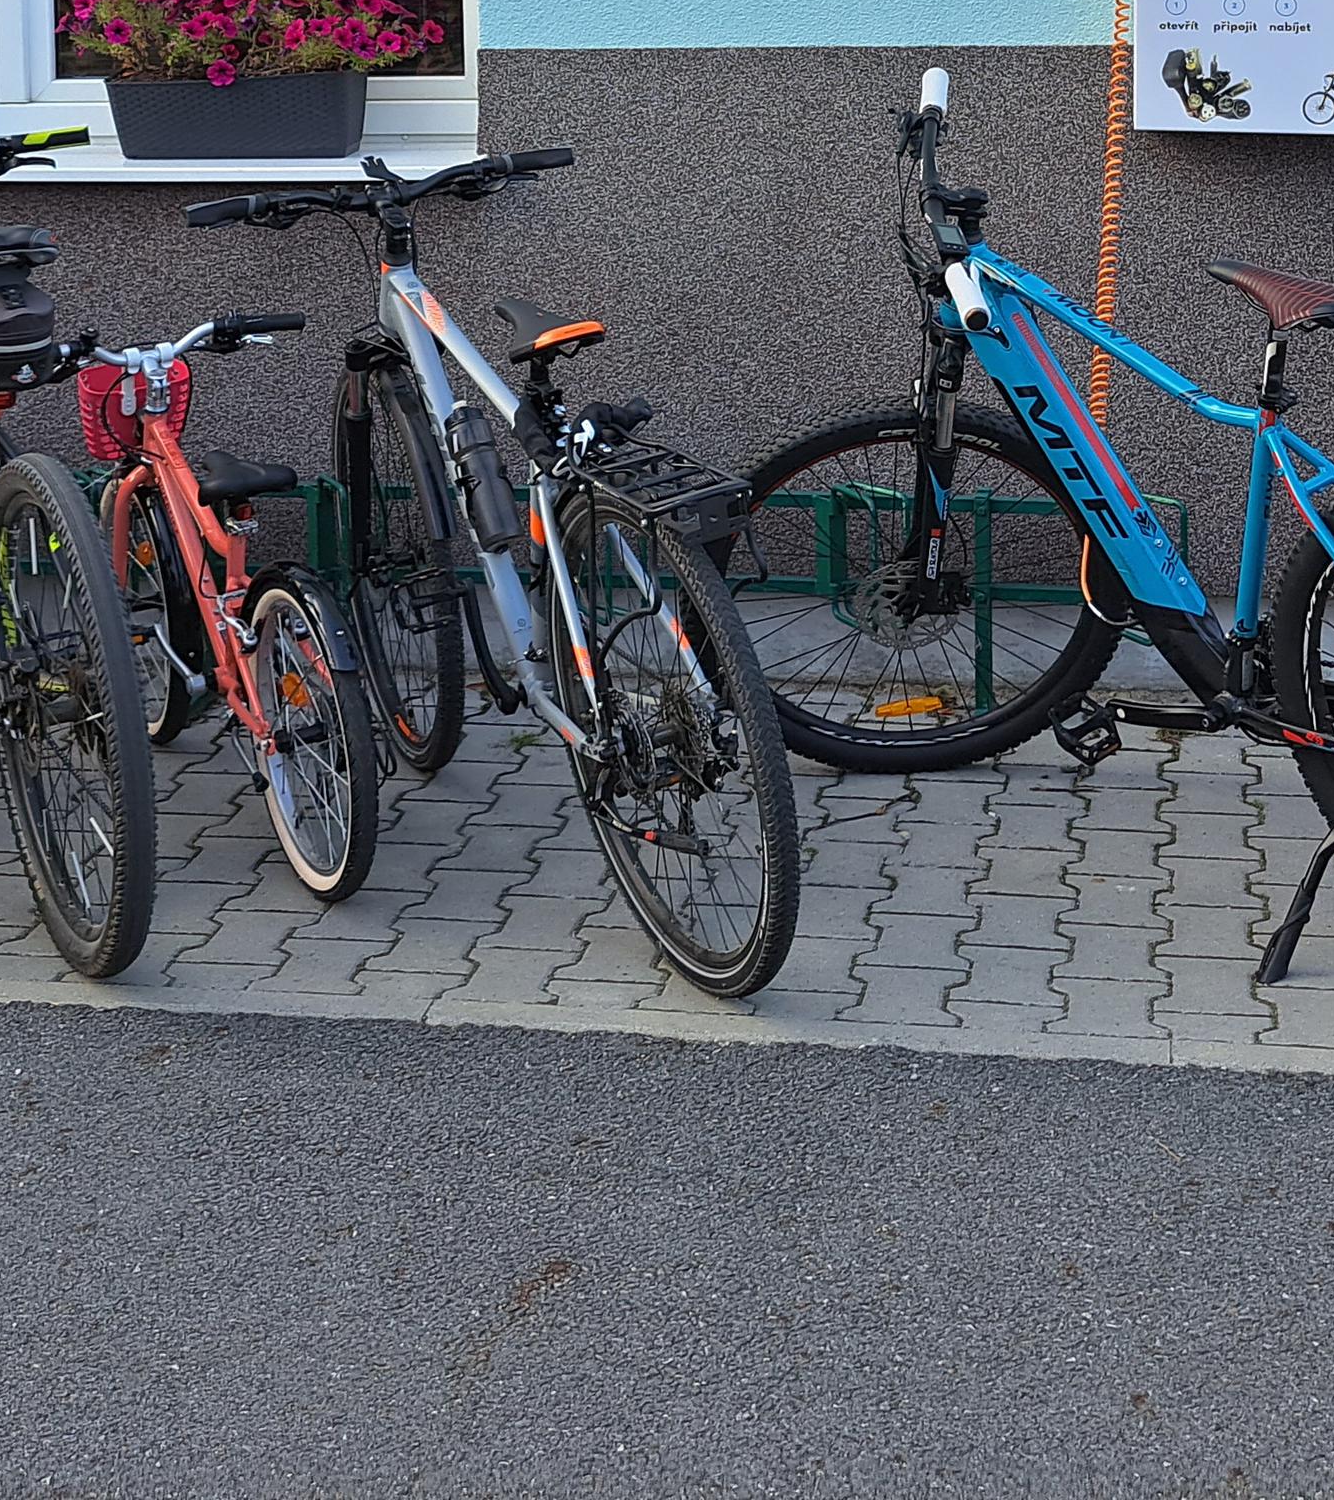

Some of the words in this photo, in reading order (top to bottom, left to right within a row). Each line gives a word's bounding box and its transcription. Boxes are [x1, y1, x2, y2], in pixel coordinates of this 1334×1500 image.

[1173, 1, 1179, 9] 1
[1231, 1, 1238, 9] 2
[1283, 2, 1289, 10] 3
[1159, 21, 1199, 31] otevřít
[1213, 21, 1258, 33] připojit
[1269, 21, 1311, 34] nabíjet
[1013, 386, 1130, 540] MTF
